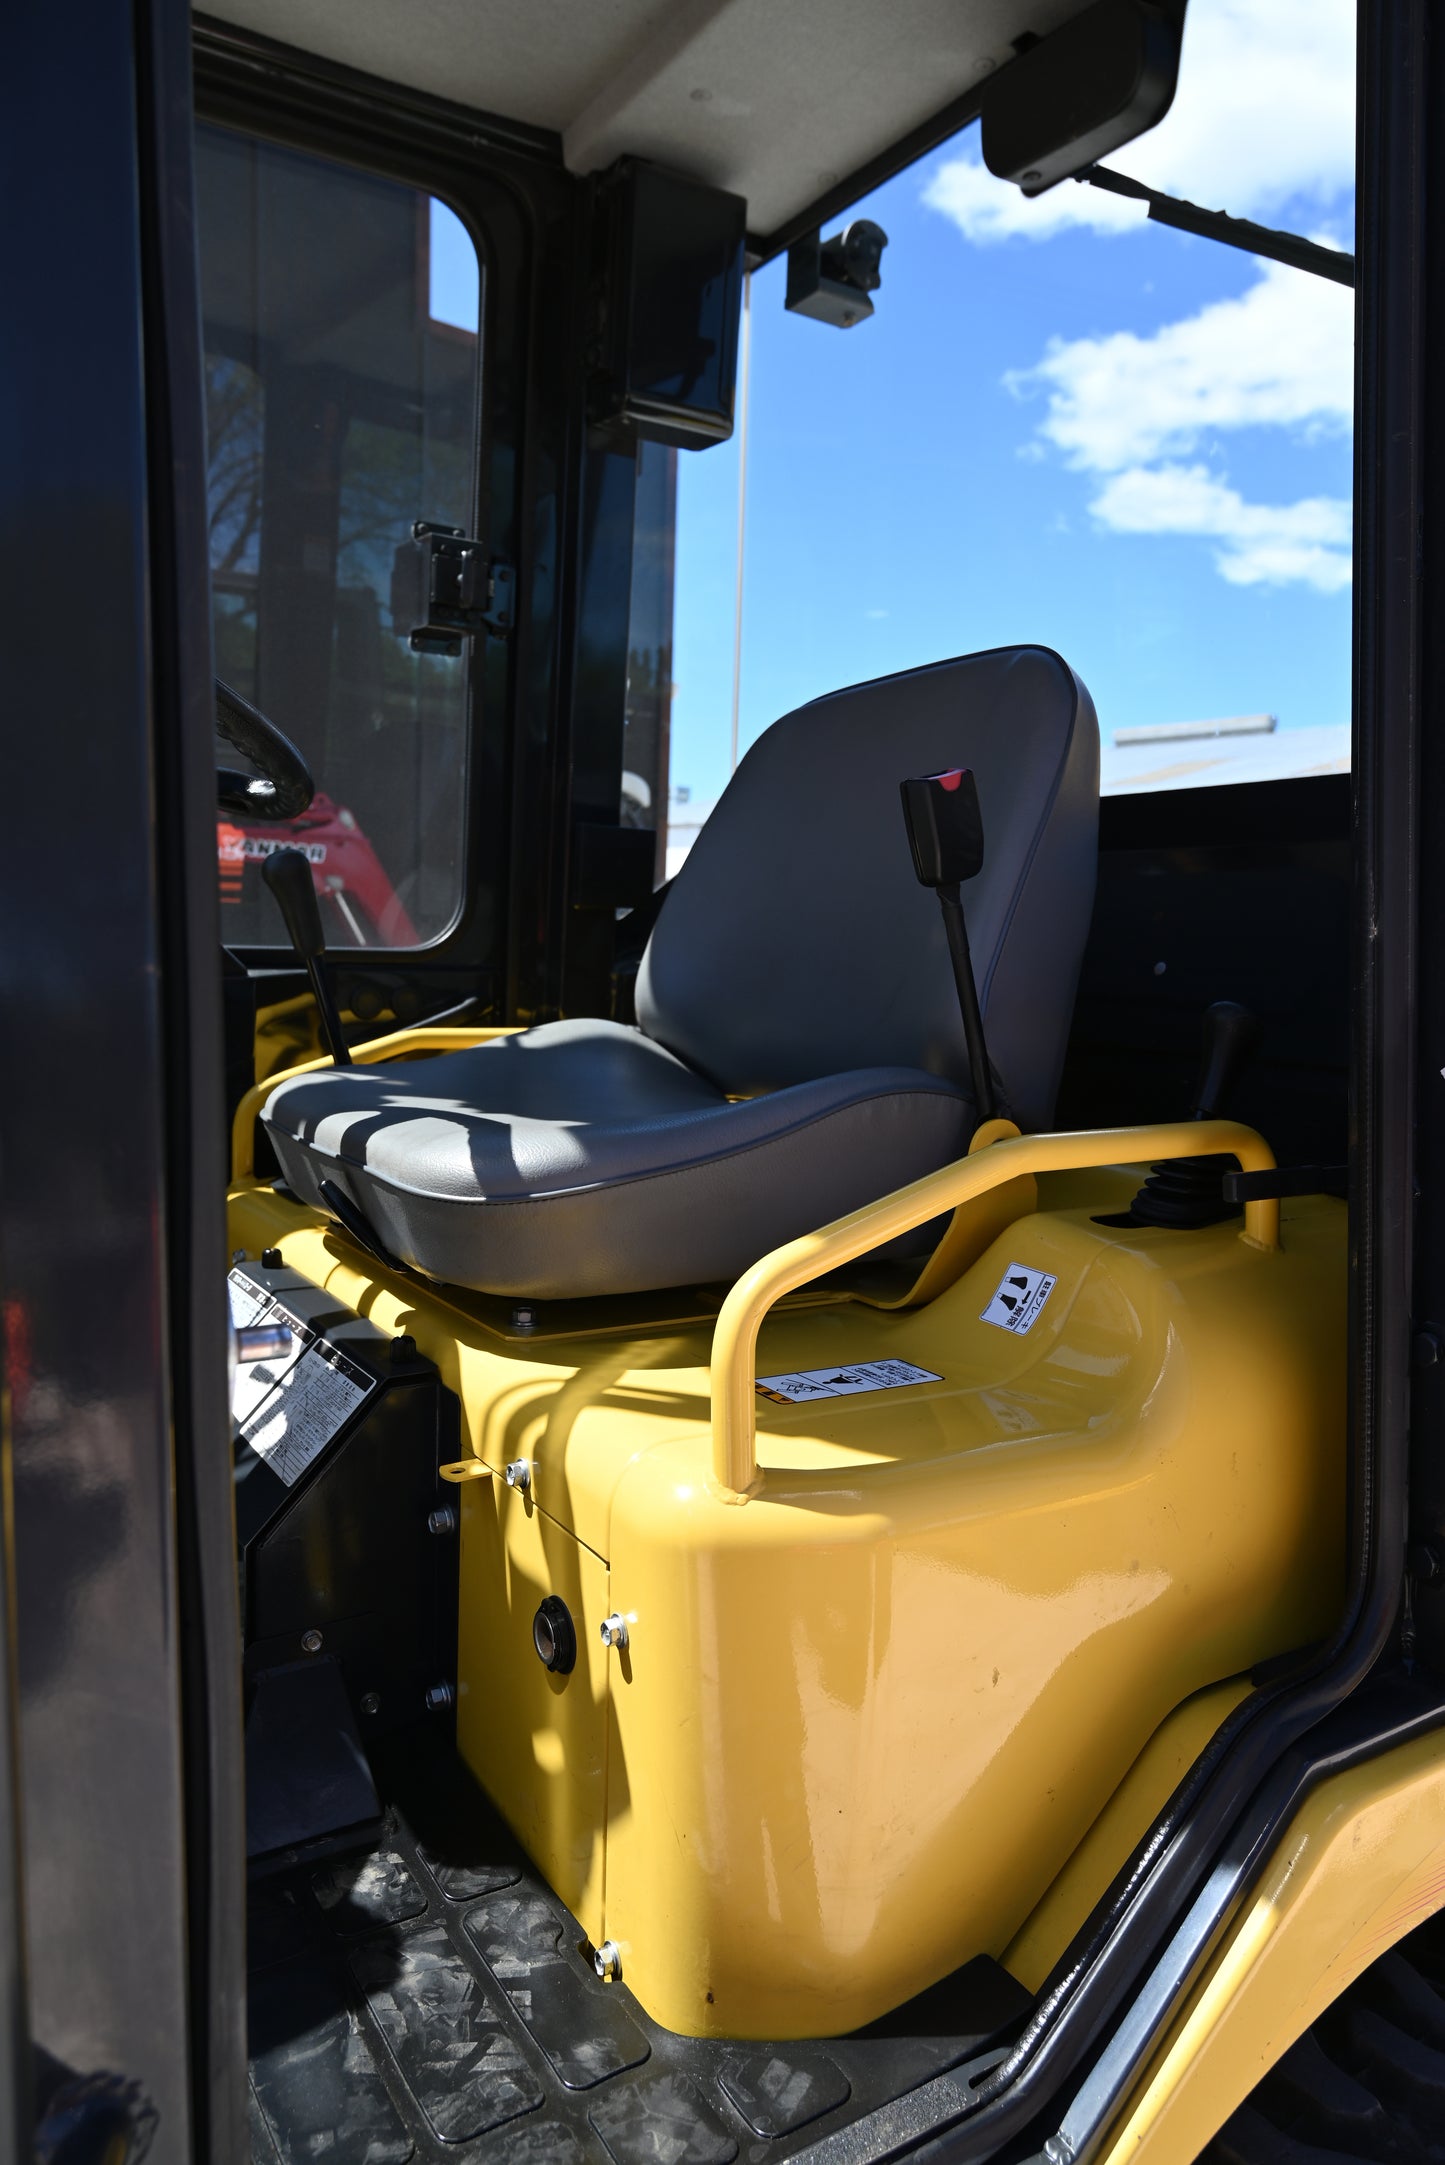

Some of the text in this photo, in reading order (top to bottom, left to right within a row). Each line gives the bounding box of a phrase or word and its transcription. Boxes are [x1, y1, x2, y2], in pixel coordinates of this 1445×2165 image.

[1021, 1280, 1053, 1330] 駐車ブレーキ
